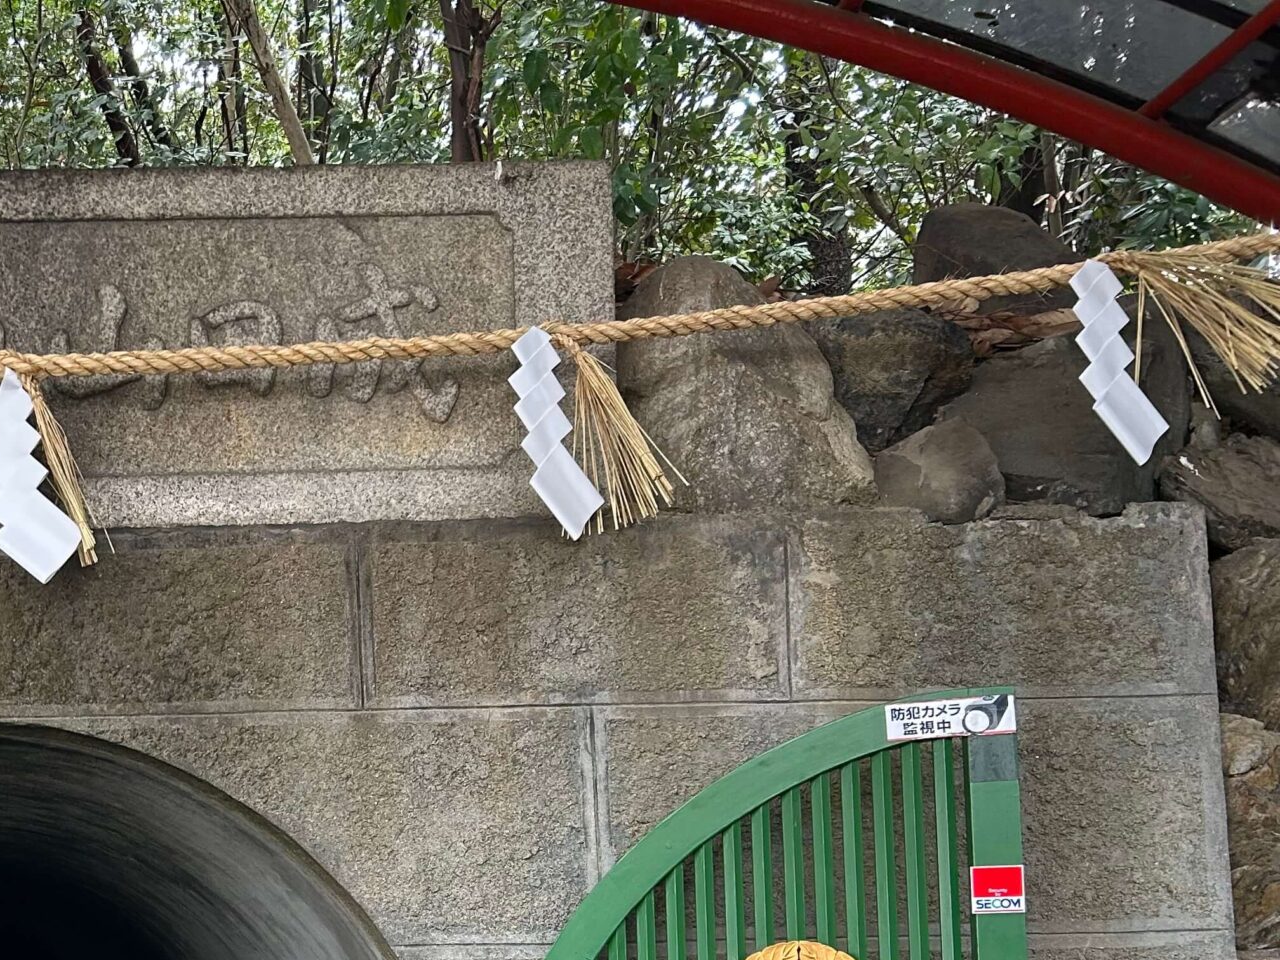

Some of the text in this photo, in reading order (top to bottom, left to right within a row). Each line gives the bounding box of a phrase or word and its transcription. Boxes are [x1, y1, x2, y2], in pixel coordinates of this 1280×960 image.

[890, 703, 961, 722] 防犯カメラ
[902, 720, 952, 736] 監視中
[976, 898, 1021, 909] SECOM
